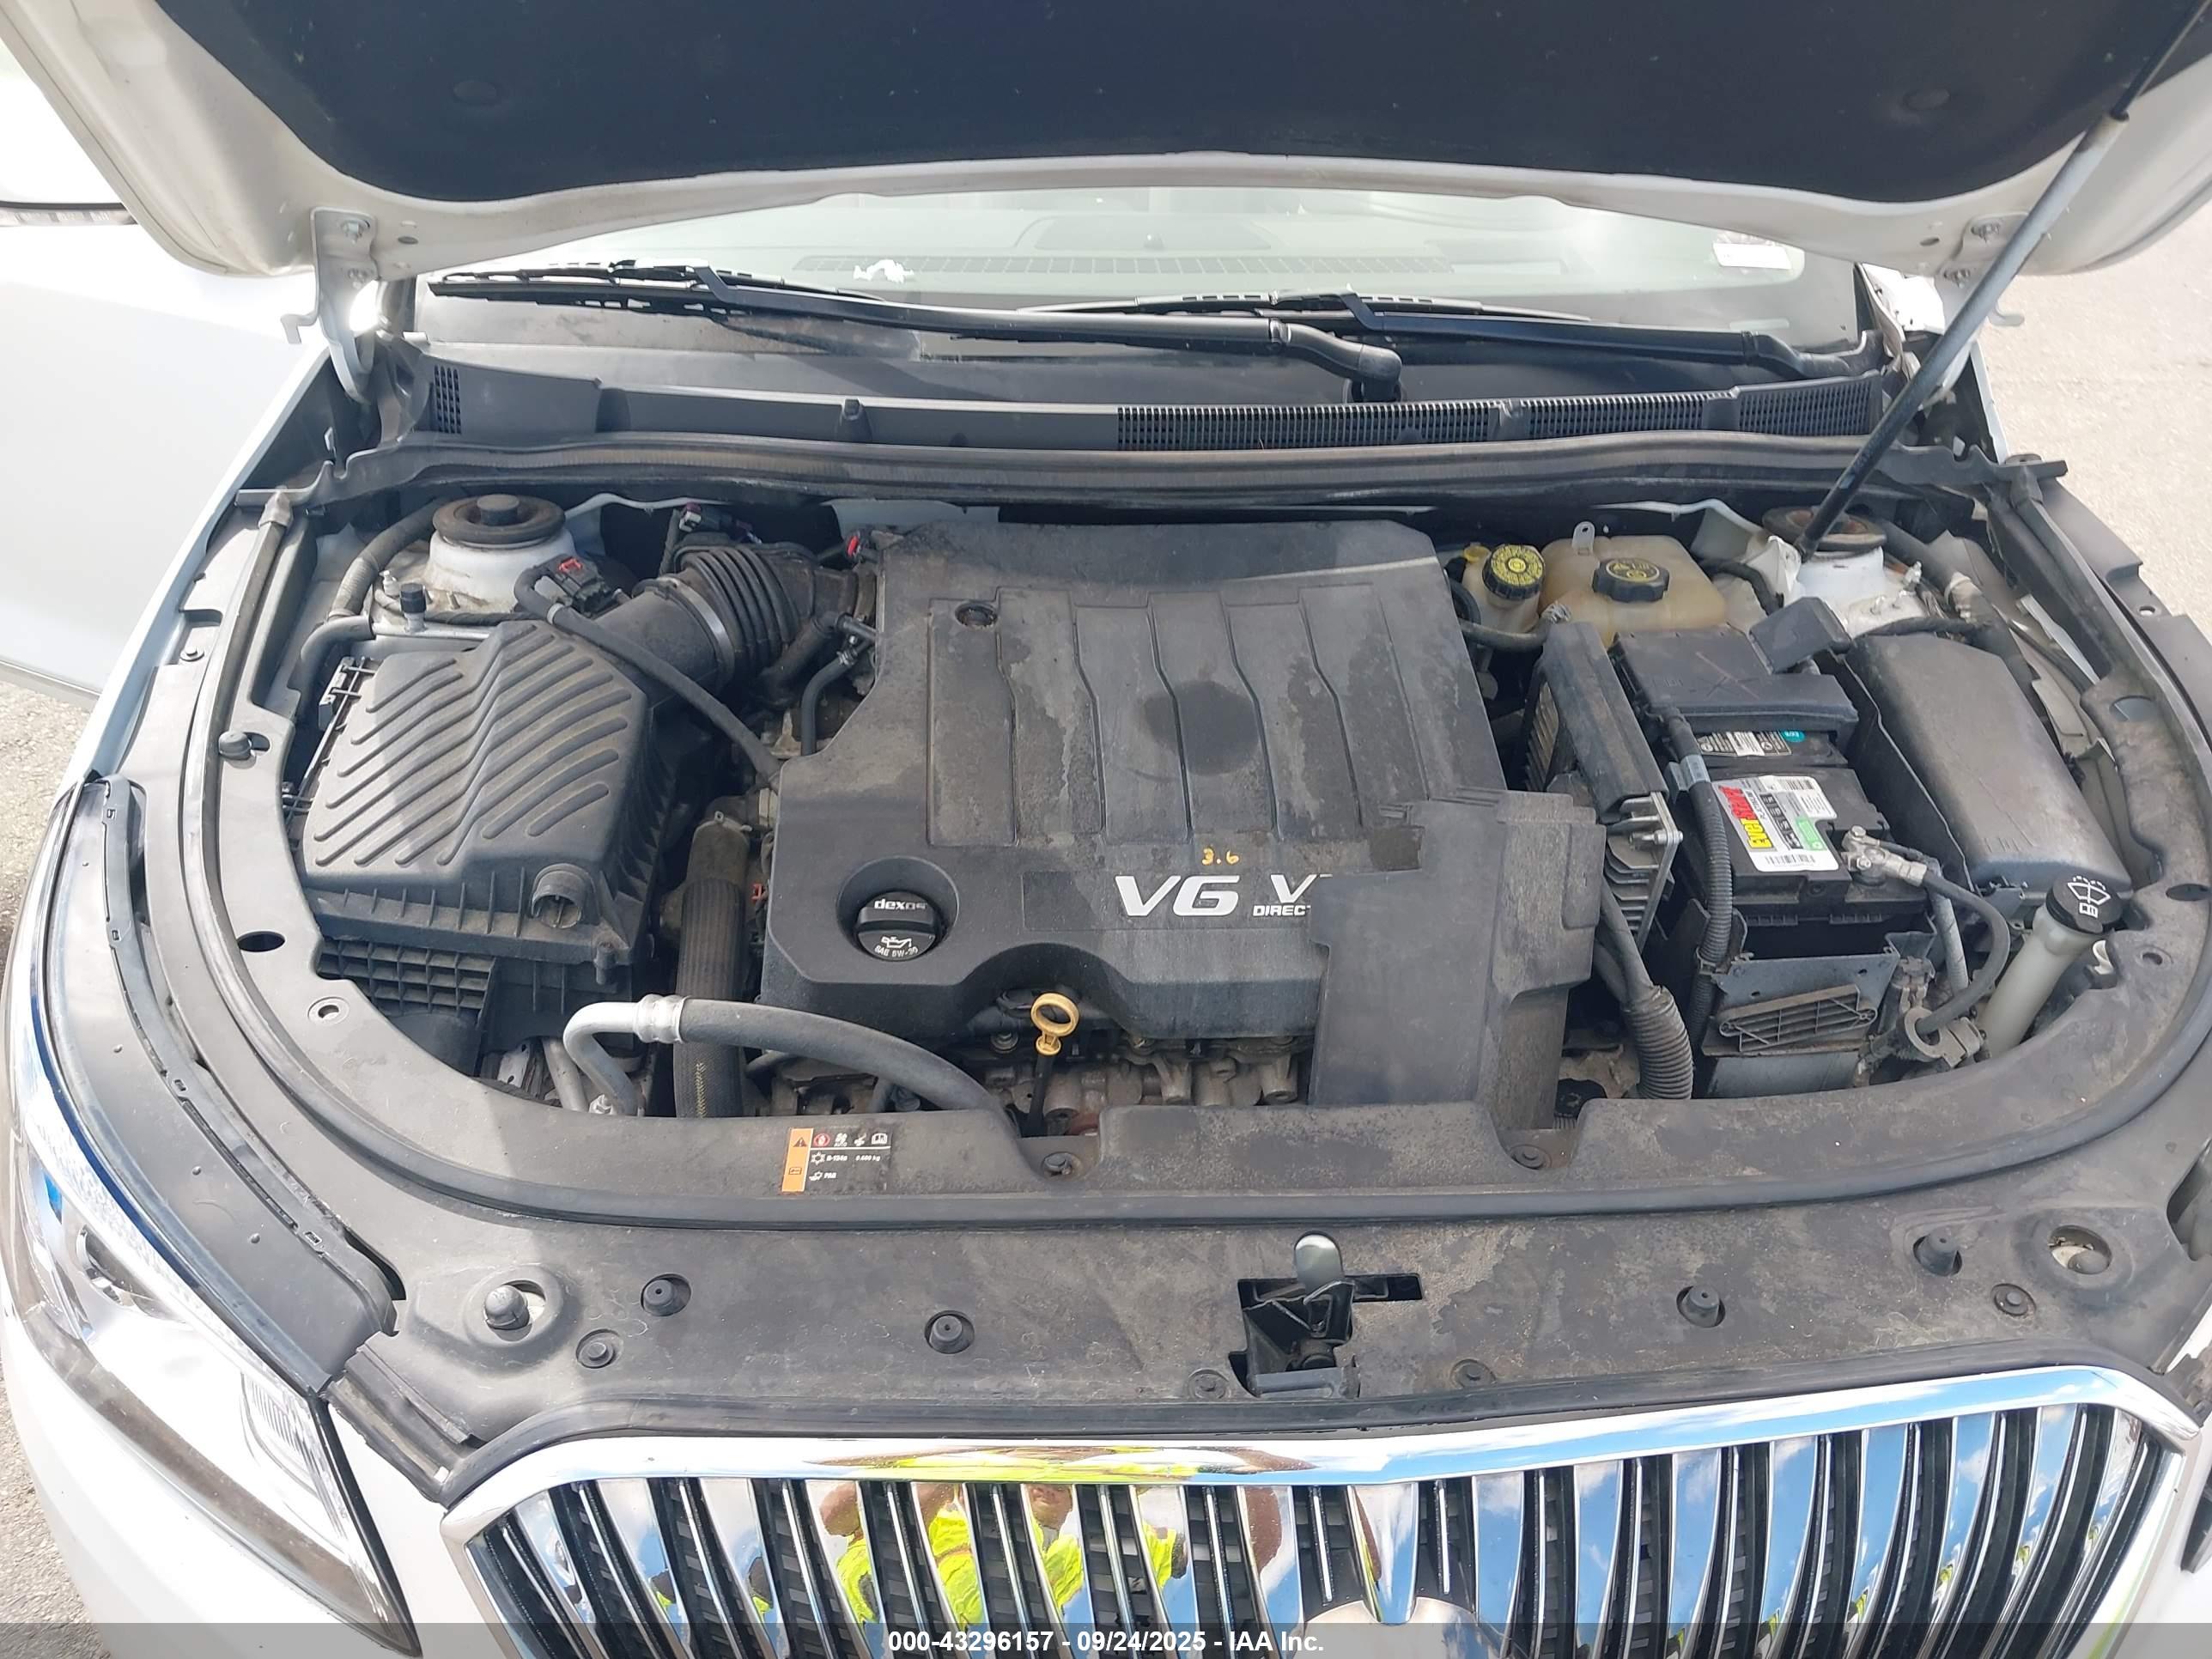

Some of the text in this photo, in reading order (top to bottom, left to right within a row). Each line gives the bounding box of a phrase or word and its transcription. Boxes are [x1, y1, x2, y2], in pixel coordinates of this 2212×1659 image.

[1717, 784, 1774, 850] EverStart
[1201, 848, 1240, 866] 3.6
[1115, 874, 1240, 916] V6
